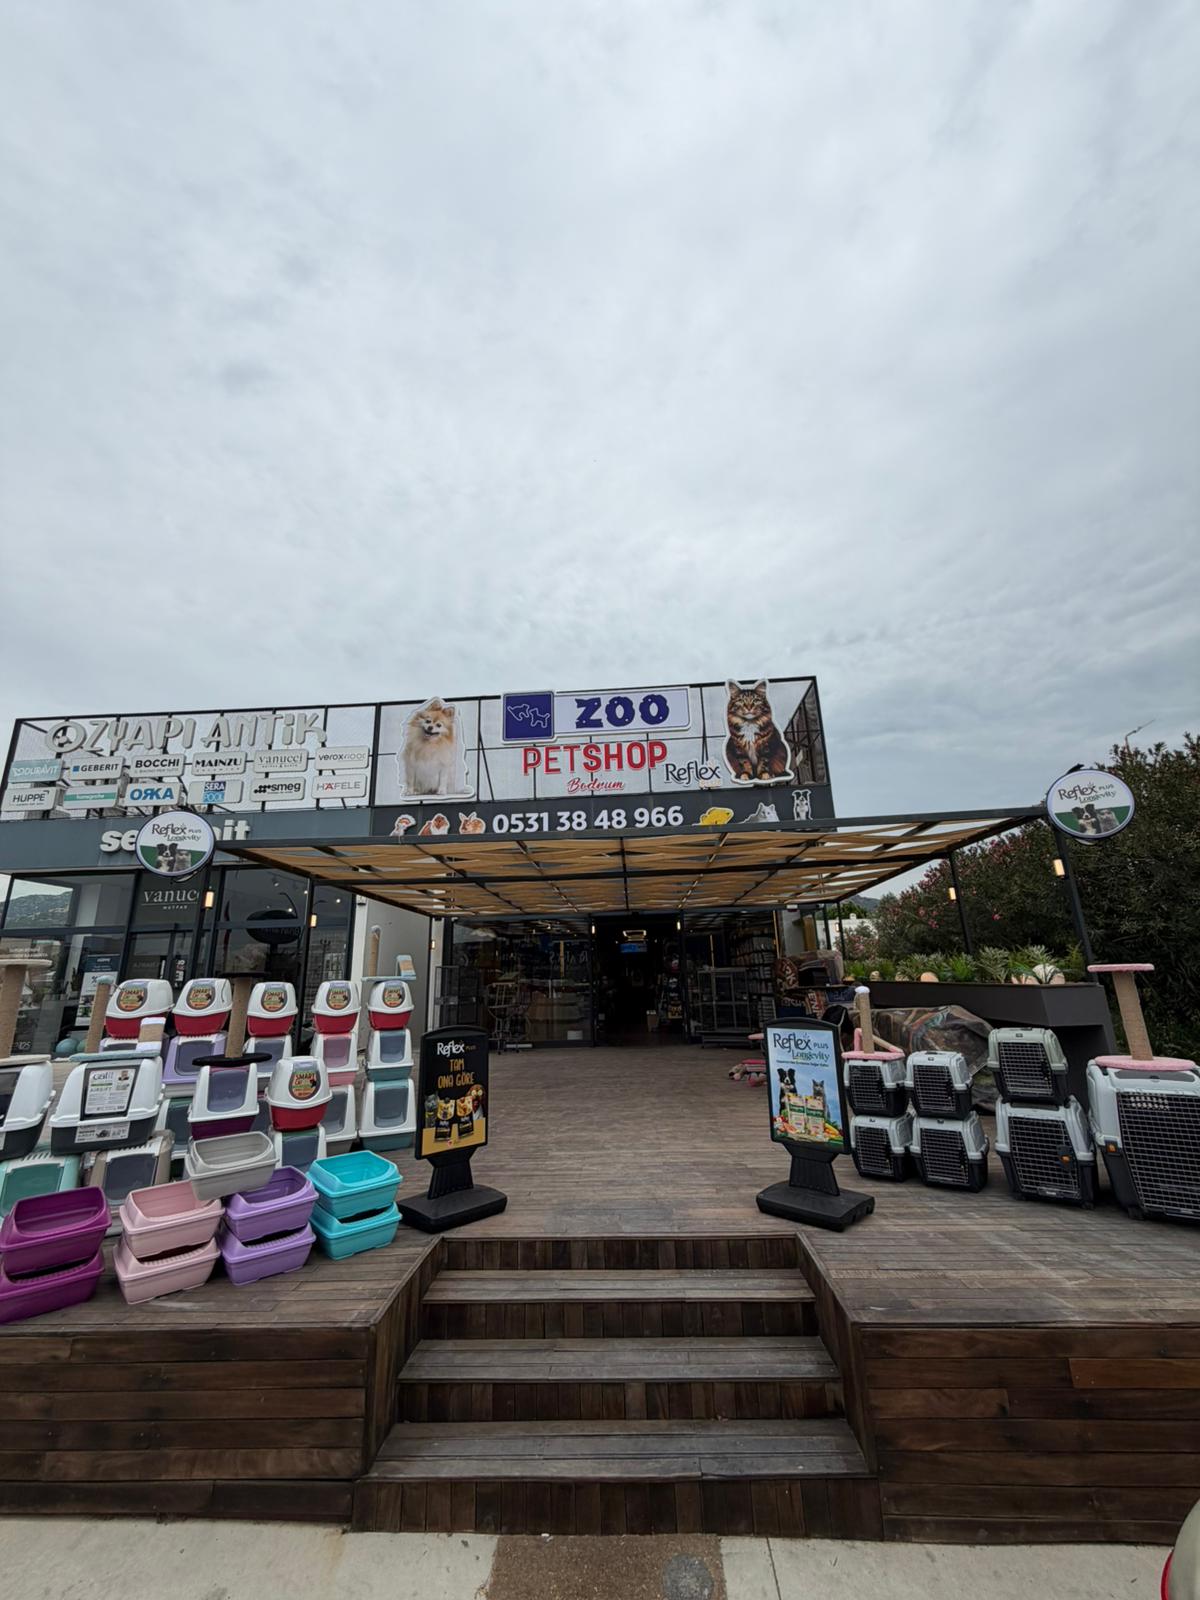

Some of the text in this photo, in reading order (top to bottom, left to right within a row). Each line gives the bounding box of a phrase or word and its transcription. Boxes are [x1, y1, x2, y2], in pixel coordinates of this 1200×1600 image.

[575, 694, 669, 729] ZOO
[135, 758, 180, 768] BOCCHI
[195, 758, 242, 768] MAINZU
[523, 740, 668, 776] PETSHOP
[80, 763, 119, 772] GEBERIT
[664, 760, 721, 786] Reflex
[270, 783, 301, 792] smeg
[567, 777, 625, 793] Bodrum
[1058, 784, 1098, 801] Reflex
[492, 805, 684, 834] 0531 38 48 966
[152, 823, 187, 838] Reflex
[436, 1040, 465, 1058] Reflex
[772, 1032, 813, 1053] Reflex
[791, 1049, 830, 1063] Longevity
[449, 1058, 465, 1071] TAM
